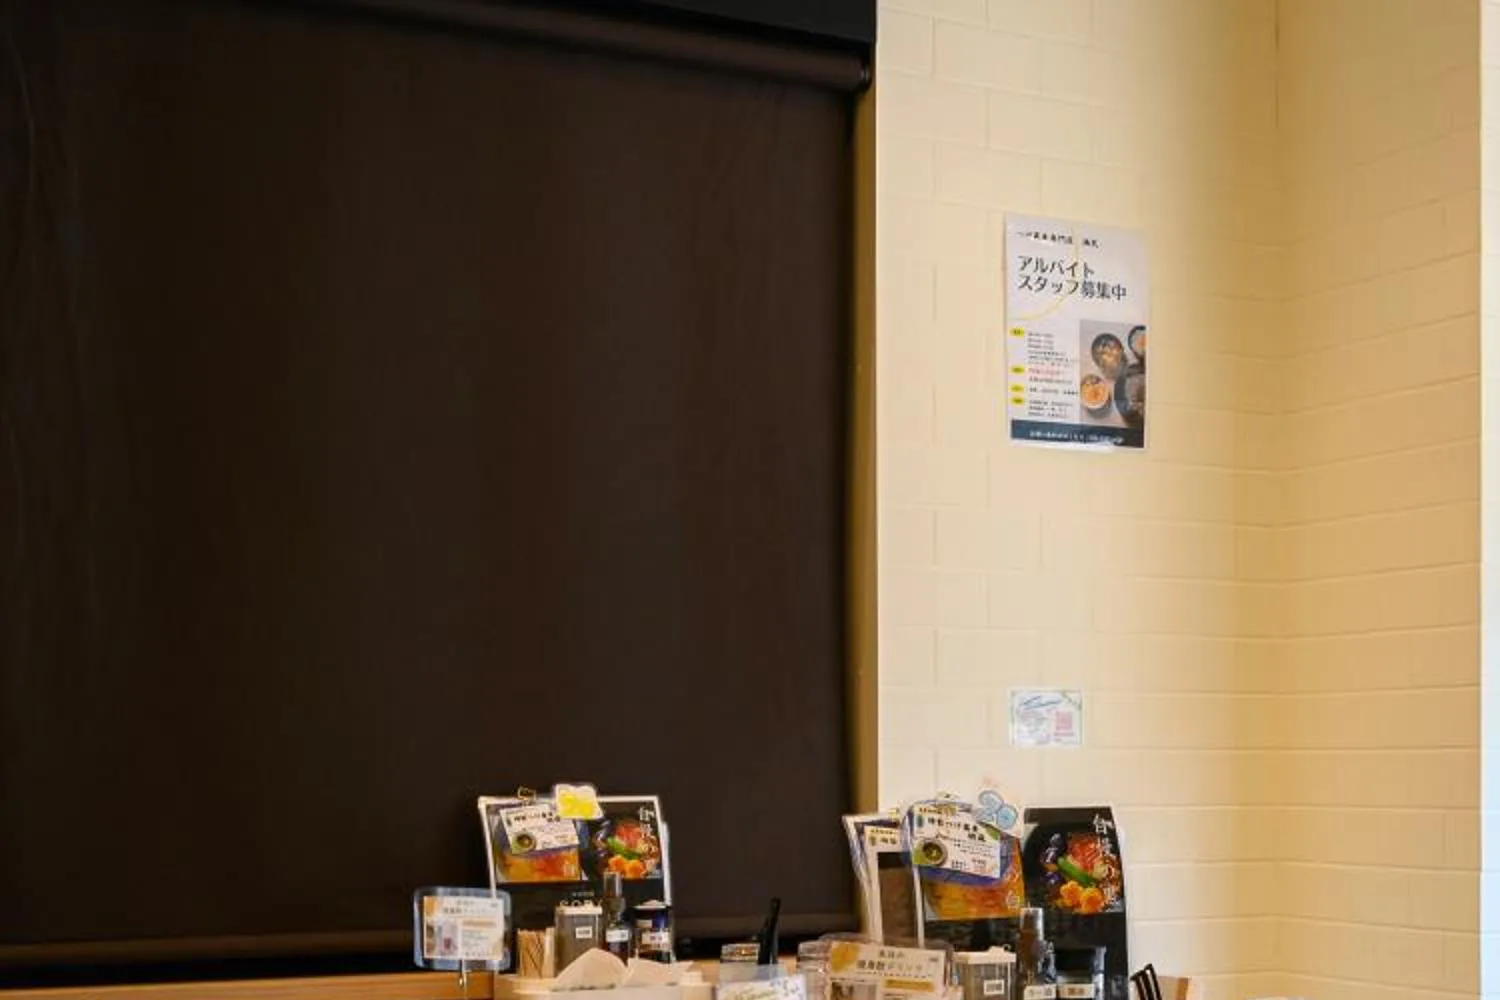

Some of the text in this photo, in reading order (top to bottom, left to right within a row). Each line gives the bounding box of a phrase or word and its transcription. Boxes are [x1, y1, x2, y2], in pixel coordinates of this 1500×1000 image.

[1017, 255, 1095, 279] アルバイト
[1017, 274, 1127, 301] スタッフ募集中
